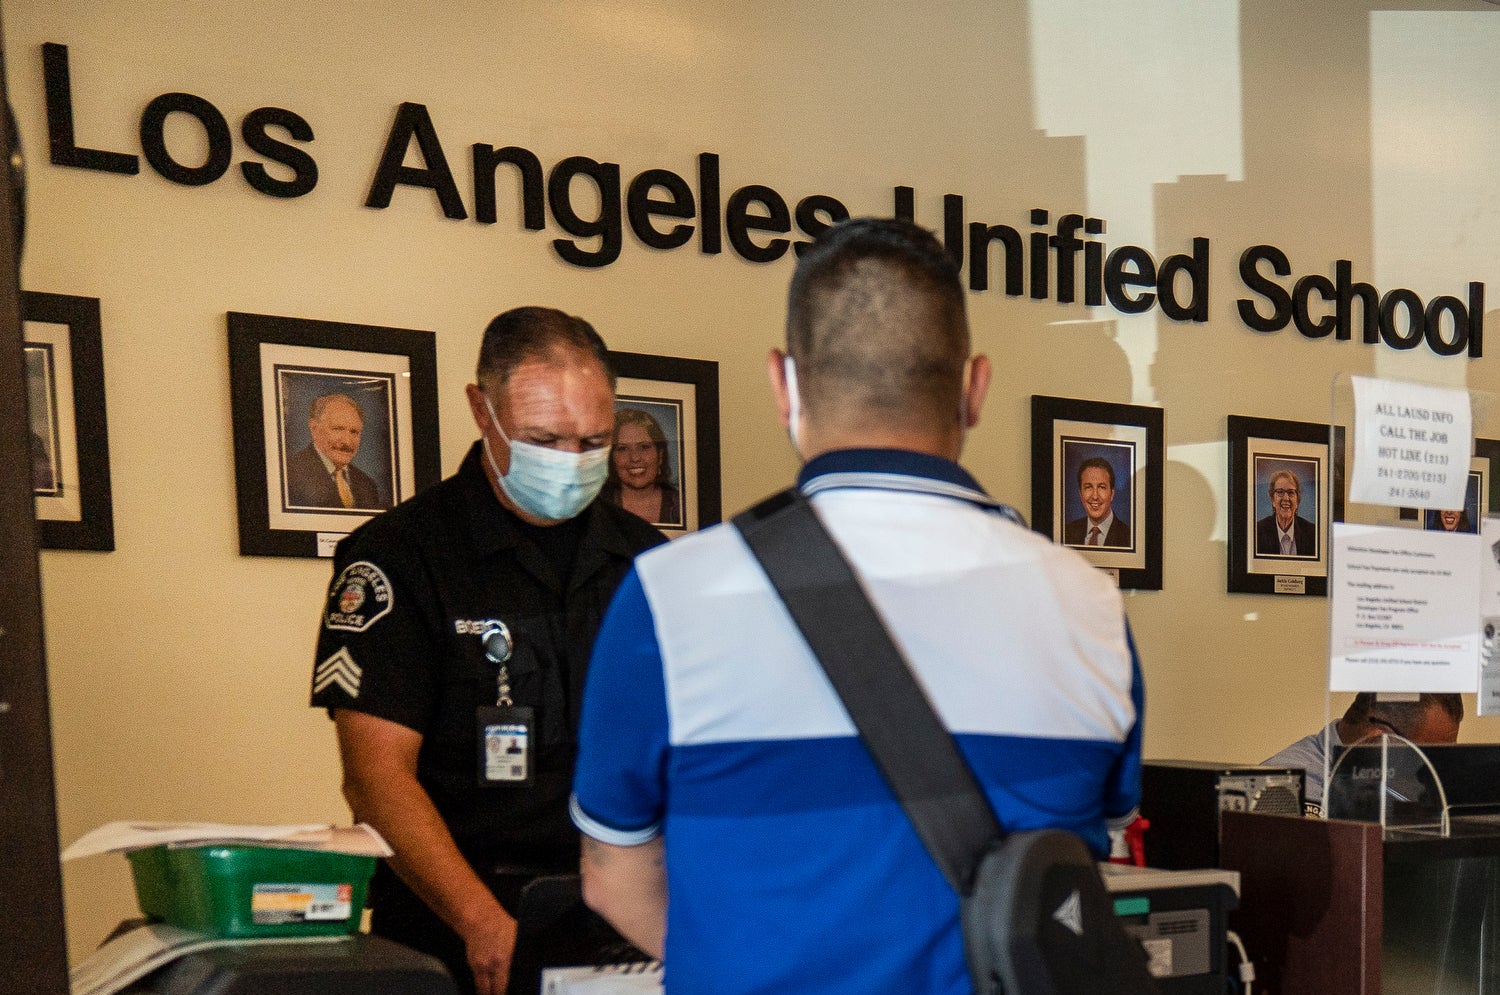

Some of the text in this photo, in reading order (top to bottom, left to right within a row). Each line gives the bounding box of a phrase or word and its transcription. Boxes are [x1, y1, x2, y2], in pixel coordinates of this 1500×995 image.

[42, 42, 319, 198] Los
[364, 101, 850, 269] Angeles
[1237, 244, 1485, 359] School
[1376, 404, 1454, 424] ALL LAUSD INFO
[1380, 424, 1448, 444] CALL THE JOB
[1378, 446, 1448, 465] HOT LINE (213)
[1352, 766, 1395, 780] Lenoo
